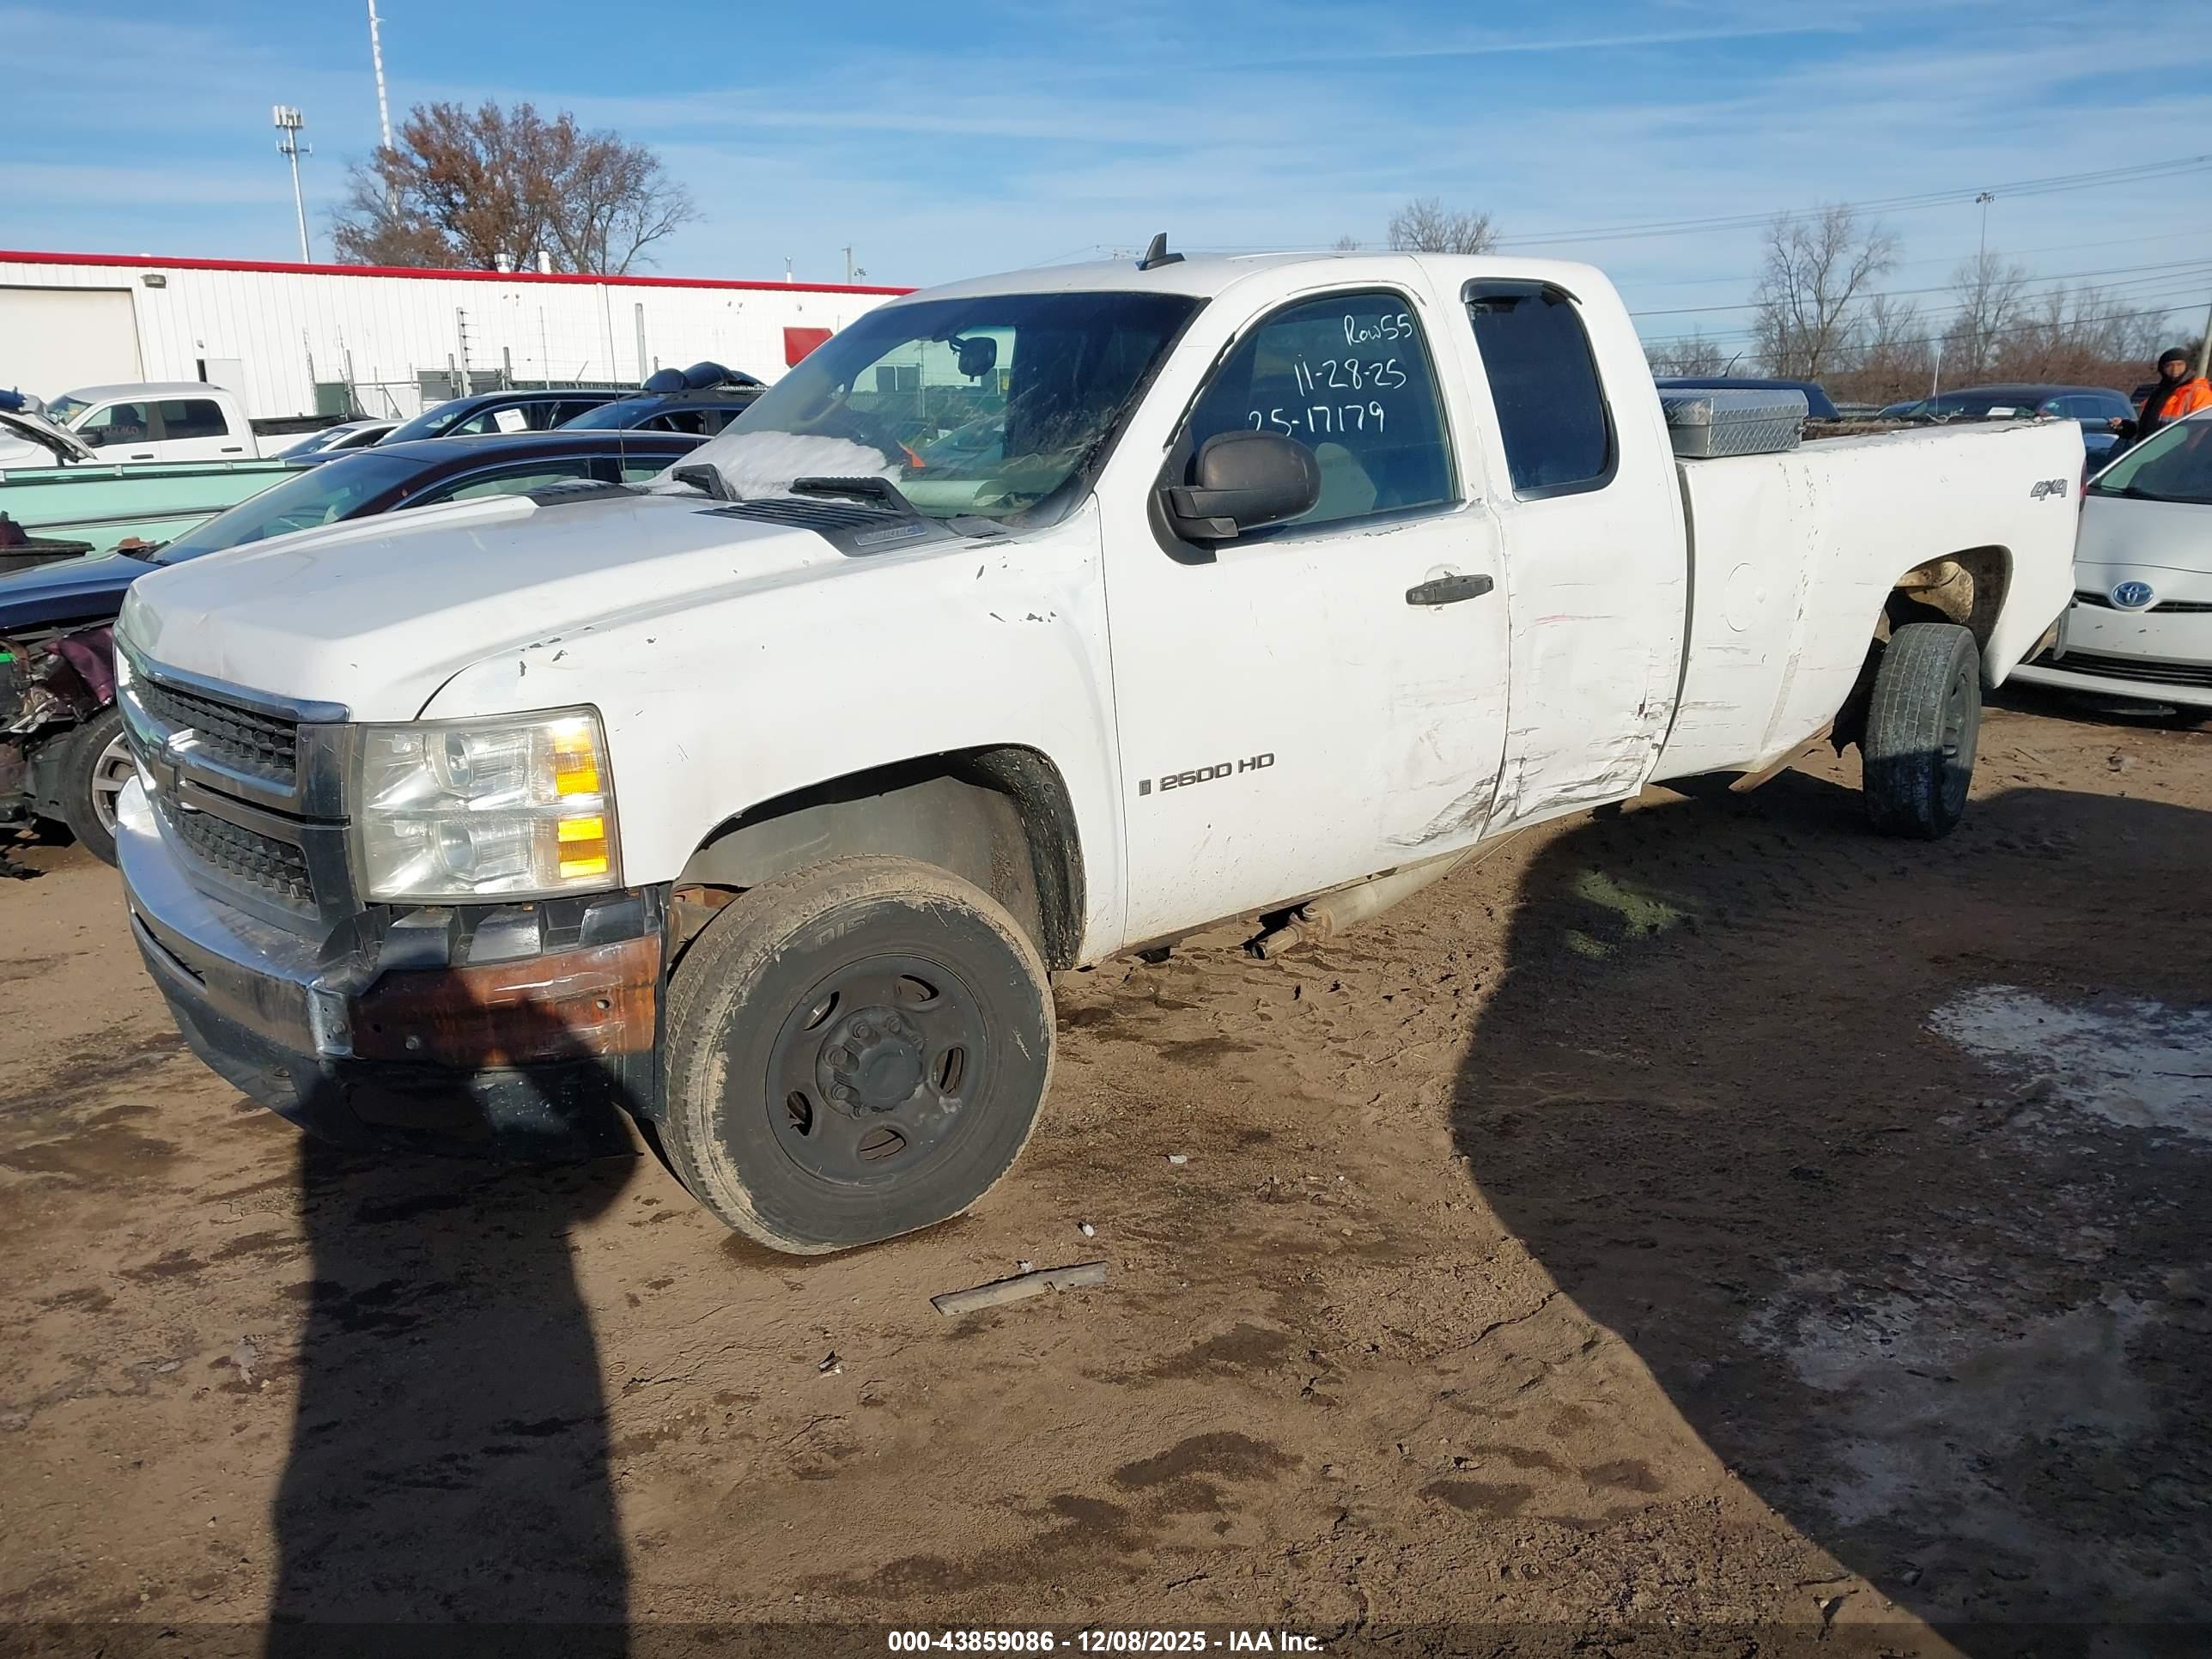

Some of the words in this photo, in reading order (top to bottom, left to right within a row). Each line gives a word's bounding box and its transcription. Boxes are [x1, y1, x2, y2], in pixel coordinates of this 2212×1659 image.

[1294, 357, 1407, 397] 11-28-25
[1249, 401, 1385, 437] 25-17179
[1159, 762, 1233, 792] 2500
[1237, 752, 1275, 774] HD
